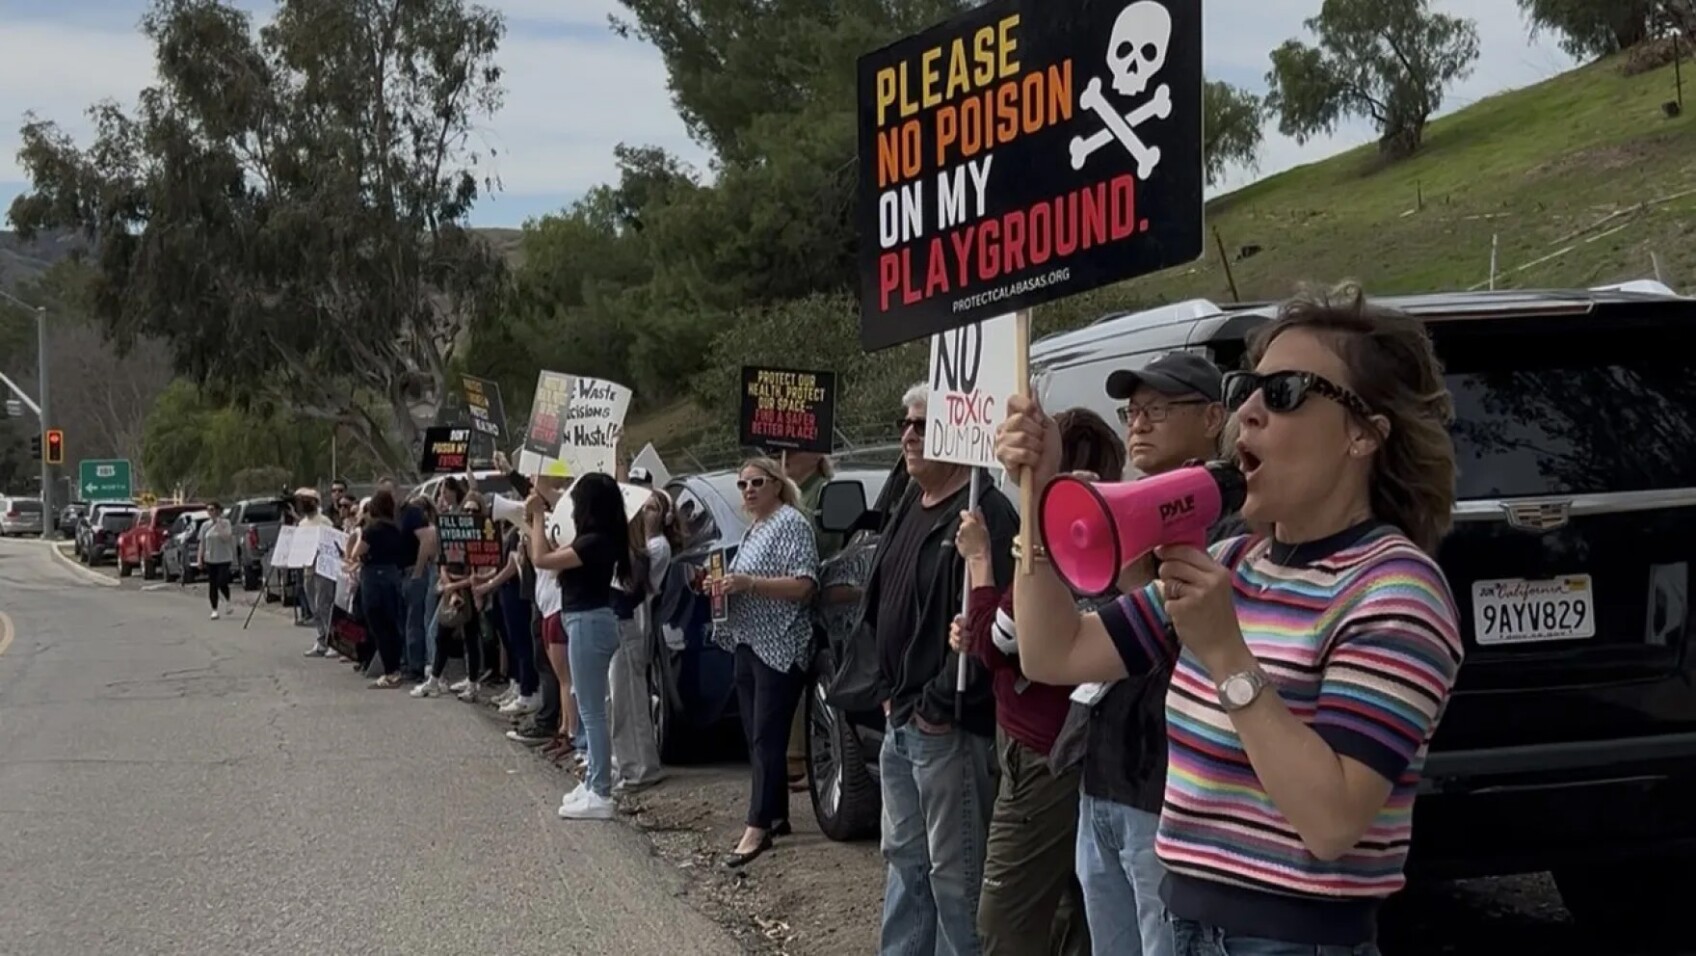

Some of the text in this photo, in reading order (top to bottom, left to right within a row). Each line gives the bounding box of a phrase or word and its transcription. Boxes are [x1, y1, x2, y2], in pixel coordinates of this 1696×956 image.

[877, 14, 1020, 126] PLEASE
[878, 59, 1072, 187] NO POISON
[879, 154, 993, 249] ON MY
[880, 174, 1149, 312] PLAYGROUND.
[952, 268, 1070, 313] PROTECTCALABASAS.ORG
[934, 321, 982, 394] NO
[758, 370, 816, 387] PROTECT OUR
[786, 386, 825, 401] PROTECT
[758, 397, 774, 409] OUR
[752, 421, 783, 437] BETTER
[932, 419, 996, 462] DUMPIN
[439, 516, 457, 527] FILL
[1158, 494, 1195, 520] PYLE
[441, 529, 481, 540] HYDRANTS
[1497, 583, 1570, 602] California
[1483, 600, 1586, 634] 9AYV829
